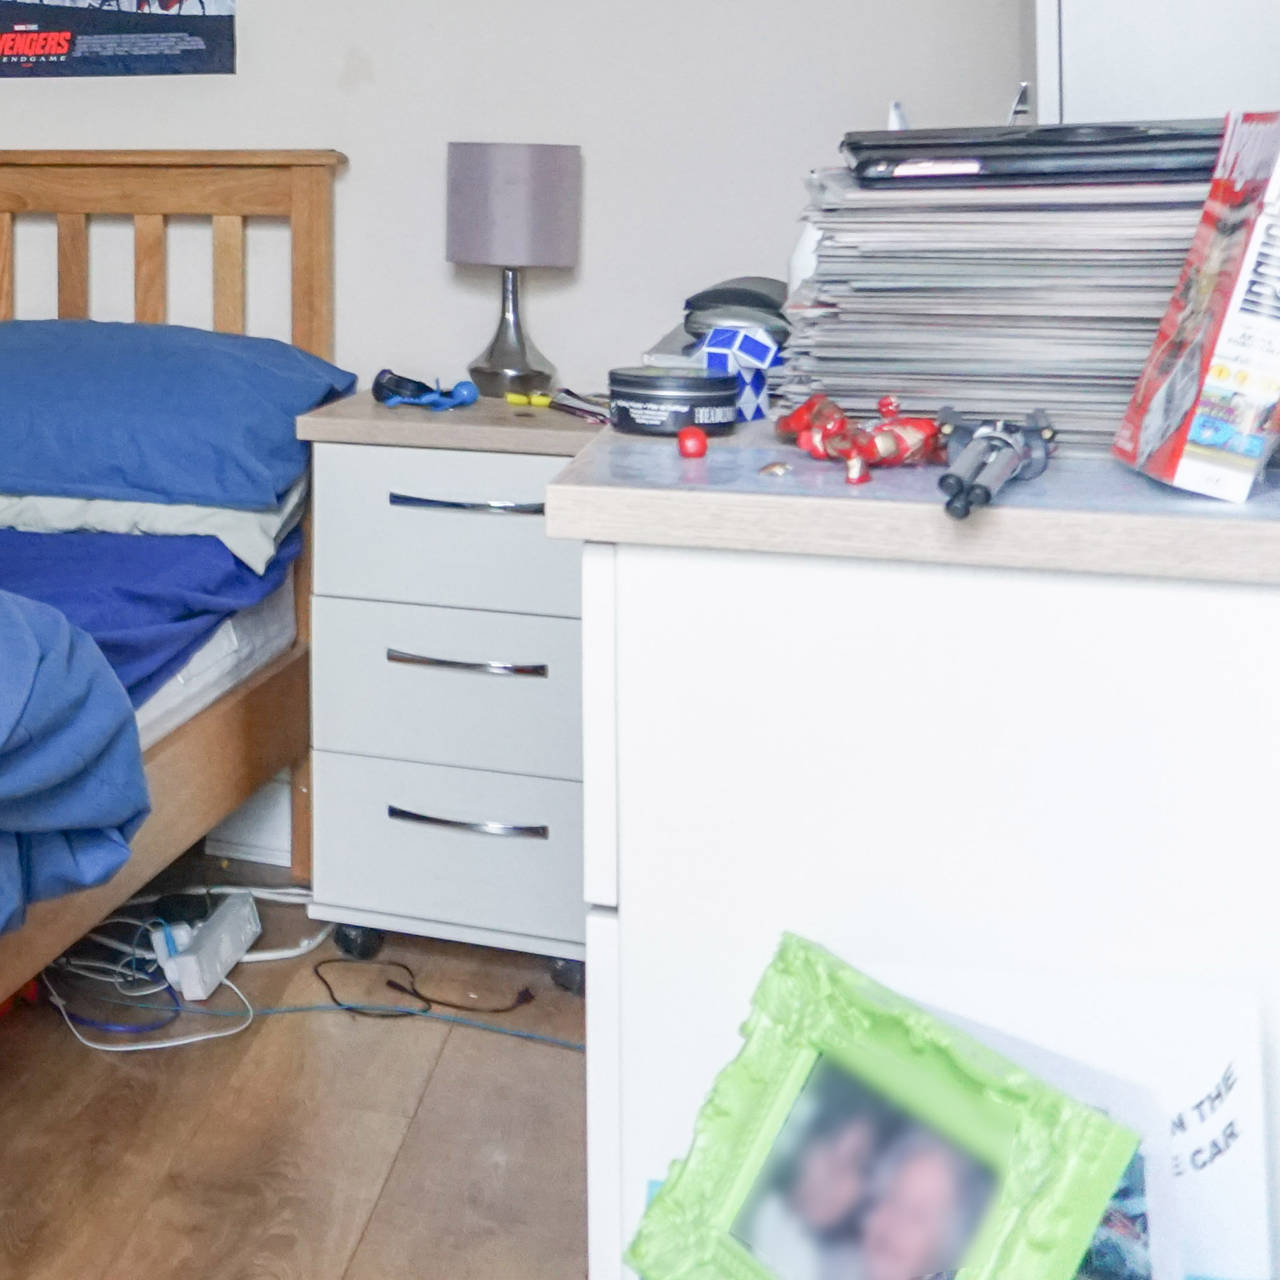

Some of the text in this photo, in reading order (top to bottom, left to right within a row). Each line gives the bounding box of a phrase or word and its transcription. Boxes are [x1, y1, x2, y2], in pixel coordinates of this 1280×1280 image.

[2, 55, 68, 63] ENDGAME
[1192, 1061, 1238, 1123] THE
[1190, 1120, 1240, 1171] CAR
